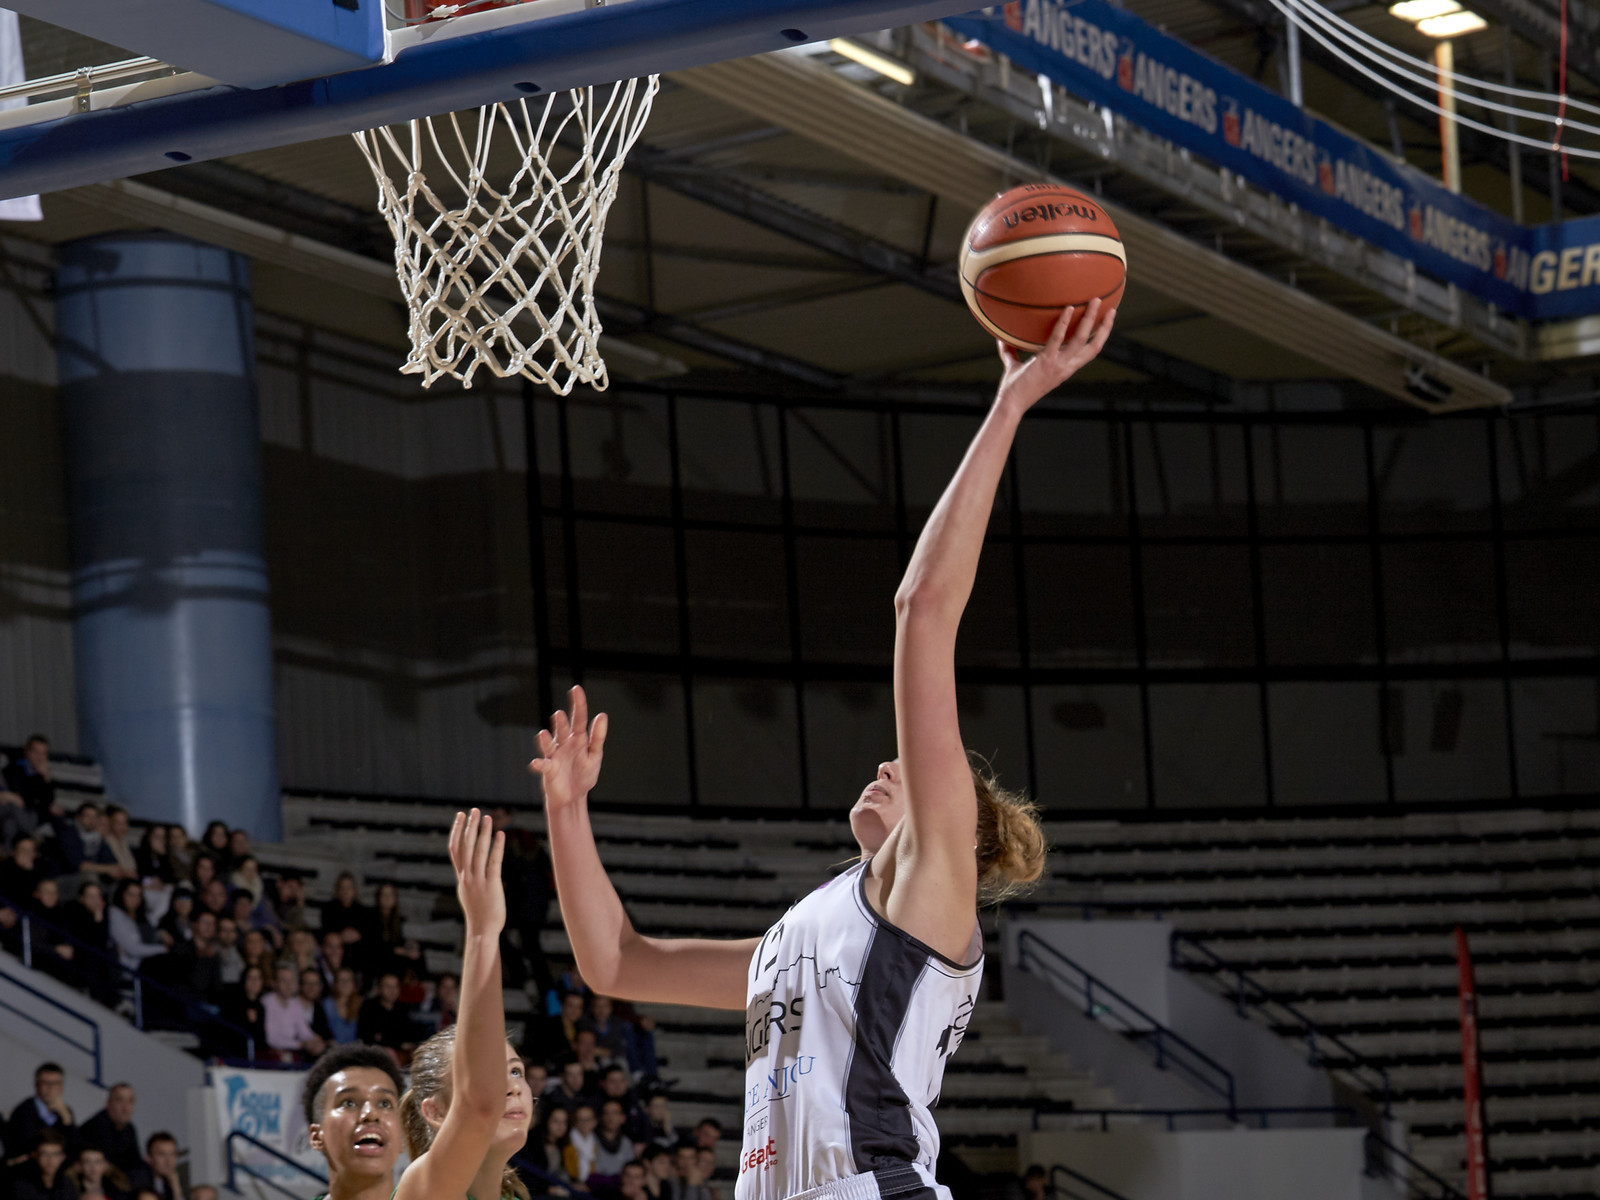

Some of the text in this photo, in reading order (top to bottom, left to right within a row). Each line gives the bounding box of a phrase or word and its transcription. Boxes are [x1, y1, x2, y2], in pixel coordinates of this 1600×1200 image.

[1023, 0, 1119, 80] ANGERS
[1133, 53, 1217, 134] ANGERS
[1240, 109, 1316, 186] ANGERS
[1003, 203, 1097, 229] molten
[1334, 159, 1405, 230] ANGERS
[1422, 204, 1491, 272] ANGERS
